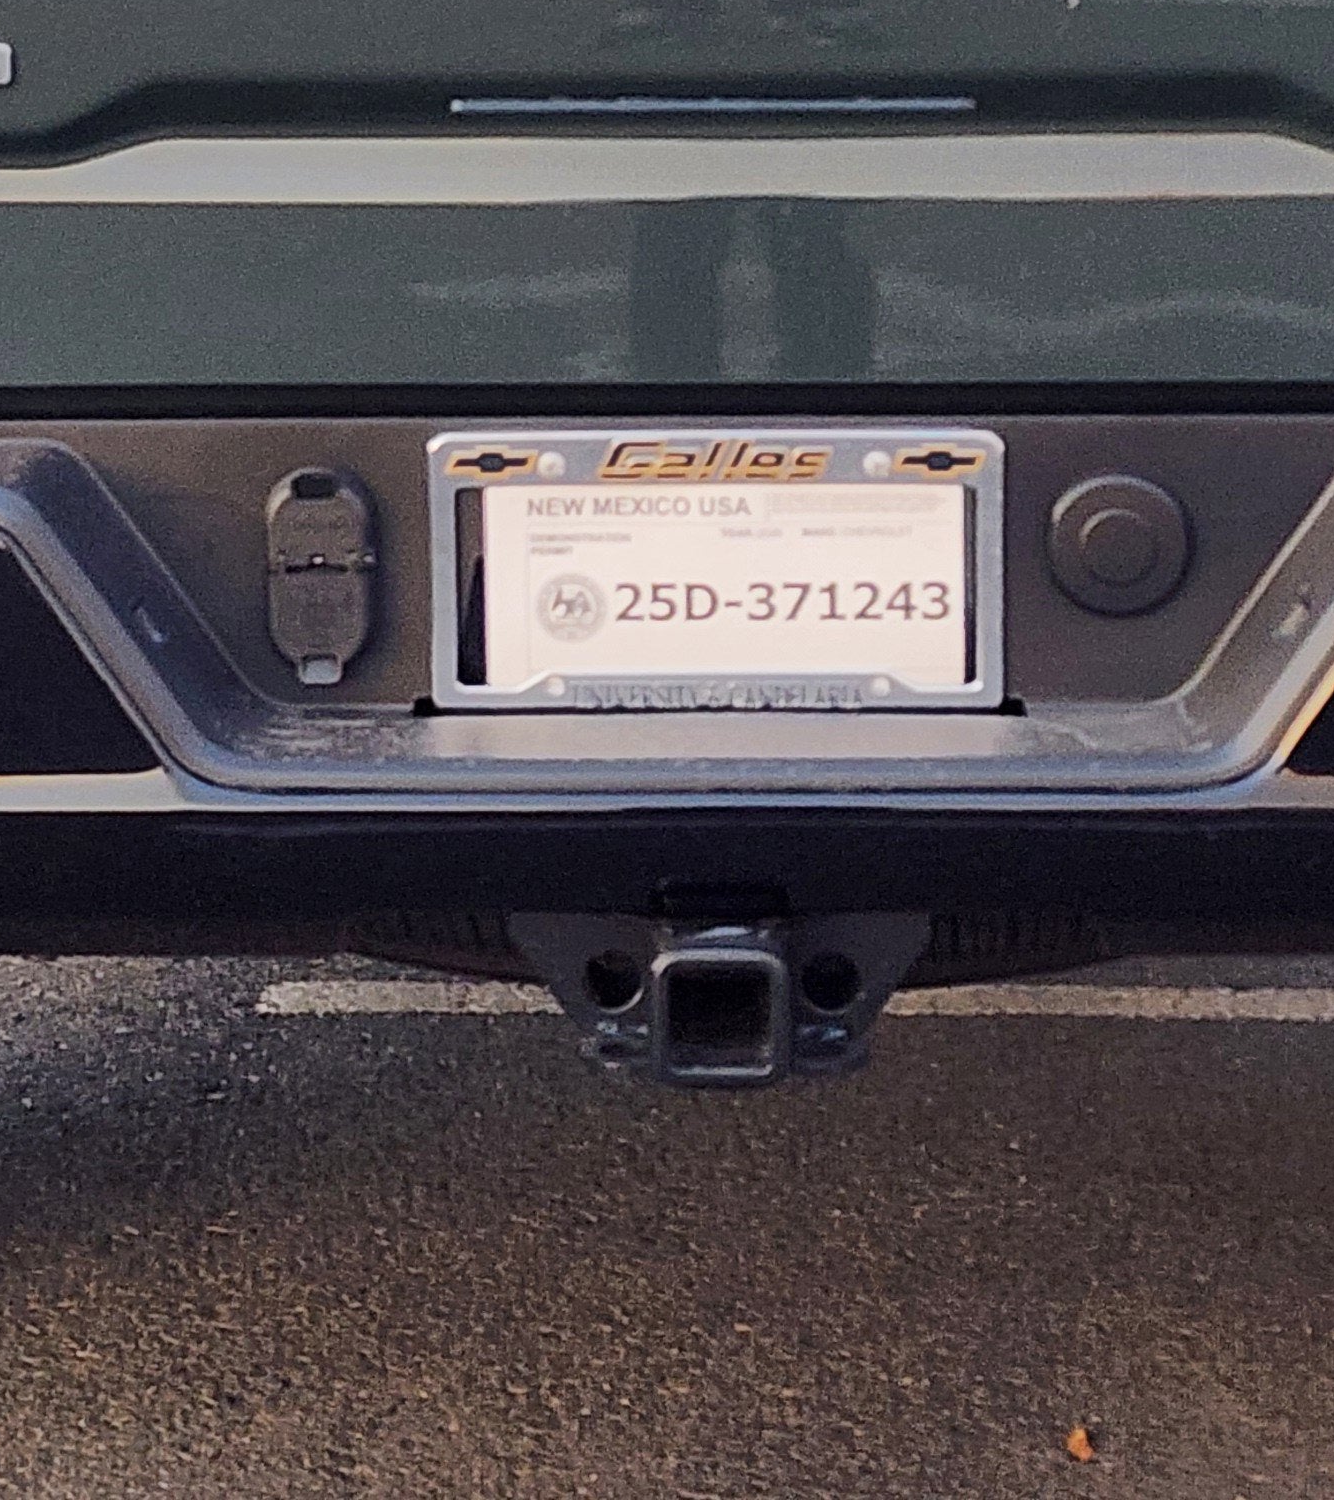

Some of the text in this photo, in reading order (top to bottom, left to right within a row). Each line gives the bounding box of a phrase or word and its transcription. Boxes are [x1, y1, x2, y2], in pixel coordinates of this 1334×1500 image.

[599, 440, 832, 480] Galles
[527, 497, 584, 516] NEW
[592, 496, 691, 516] MEXICO
[698, 496, 752, 516] USA
[615, 582, 950, 621] 25D-371243
